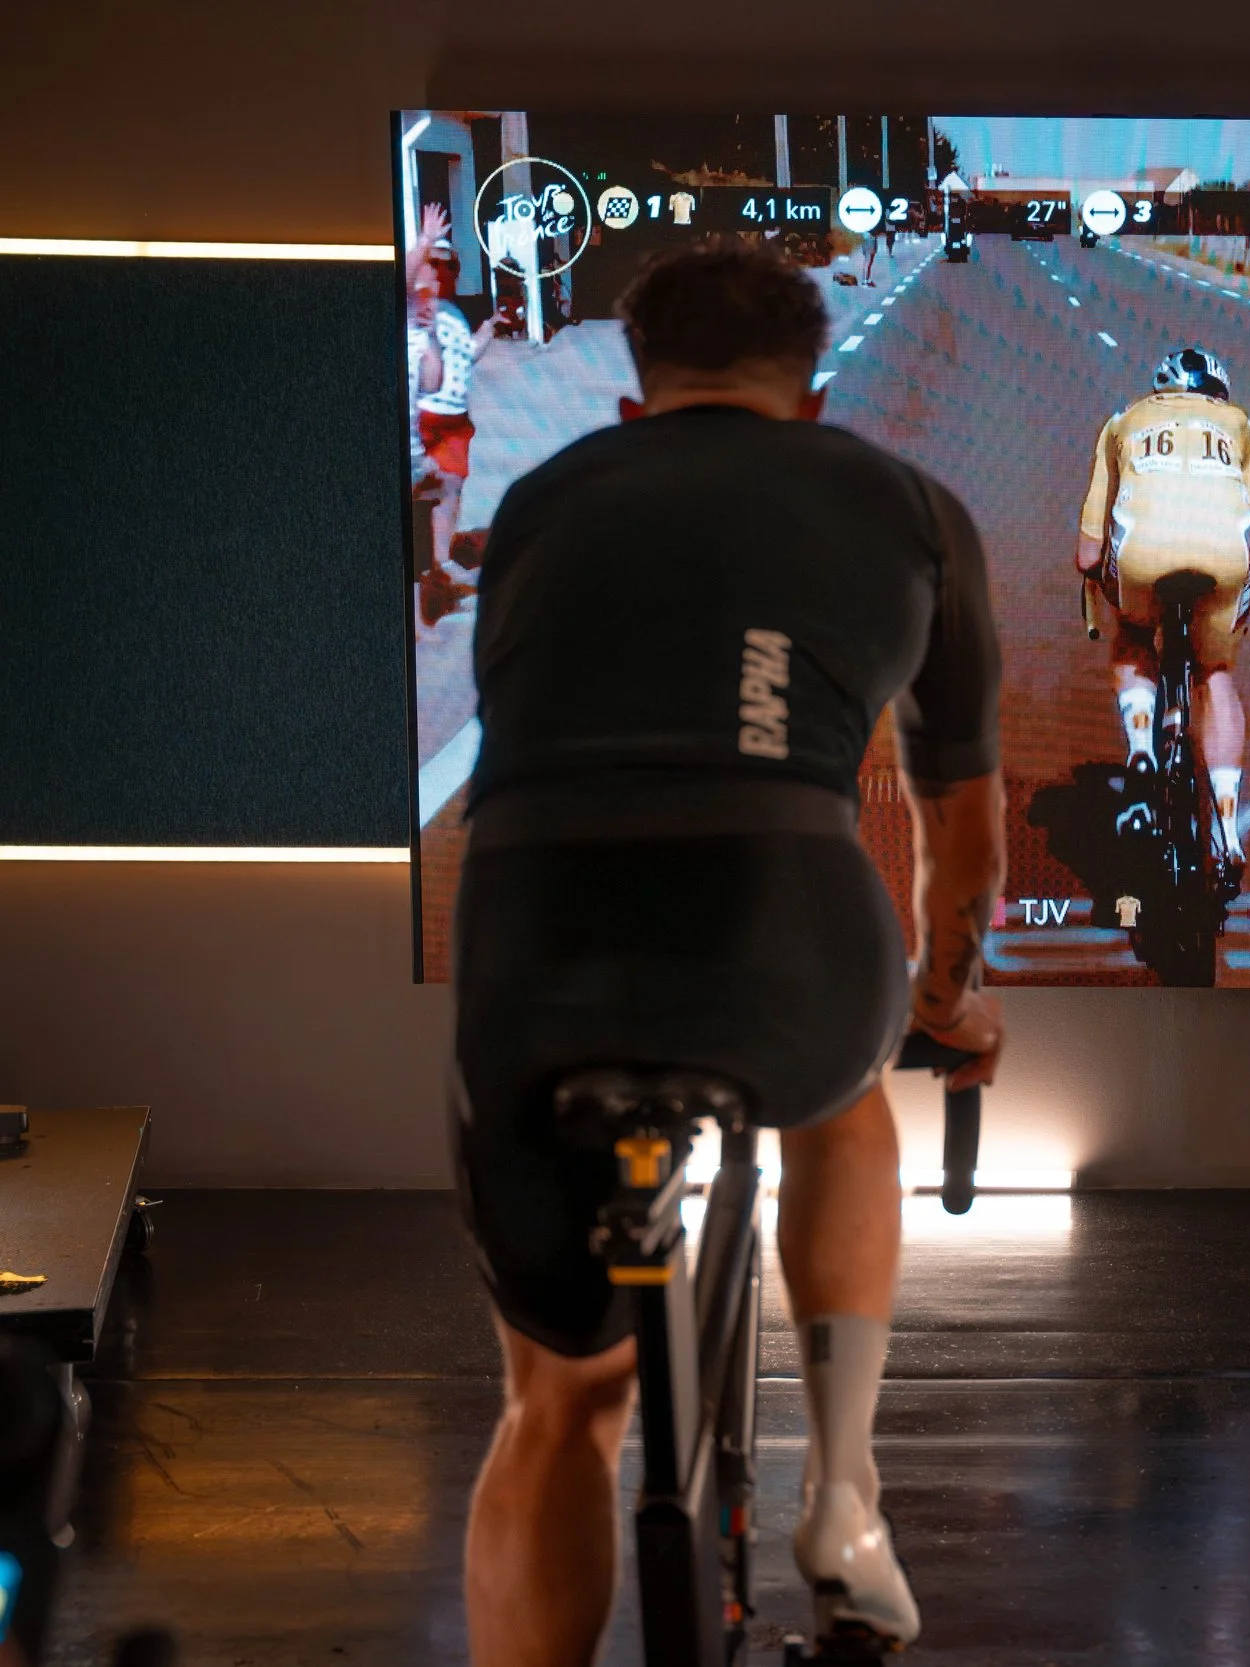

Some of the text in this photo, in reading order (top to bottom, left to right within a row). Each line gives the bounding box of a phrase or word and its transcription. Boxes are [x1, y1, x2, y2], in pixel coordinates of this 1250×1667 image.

[647, 195, 661, 218] 1
[742, 198, 821, 222] 4,1 km
[888, 198, 908, 220] 2
[1027, 200, 1066, 222] 27"
[1133, 200, 1152, 222] 3
[1140, 430, 1174, 460] 16
[1202, 431, 1231, 466] 16
[738, 628, 792, 760] RAPHA
[1019, 899, 1071, 925] TJV
